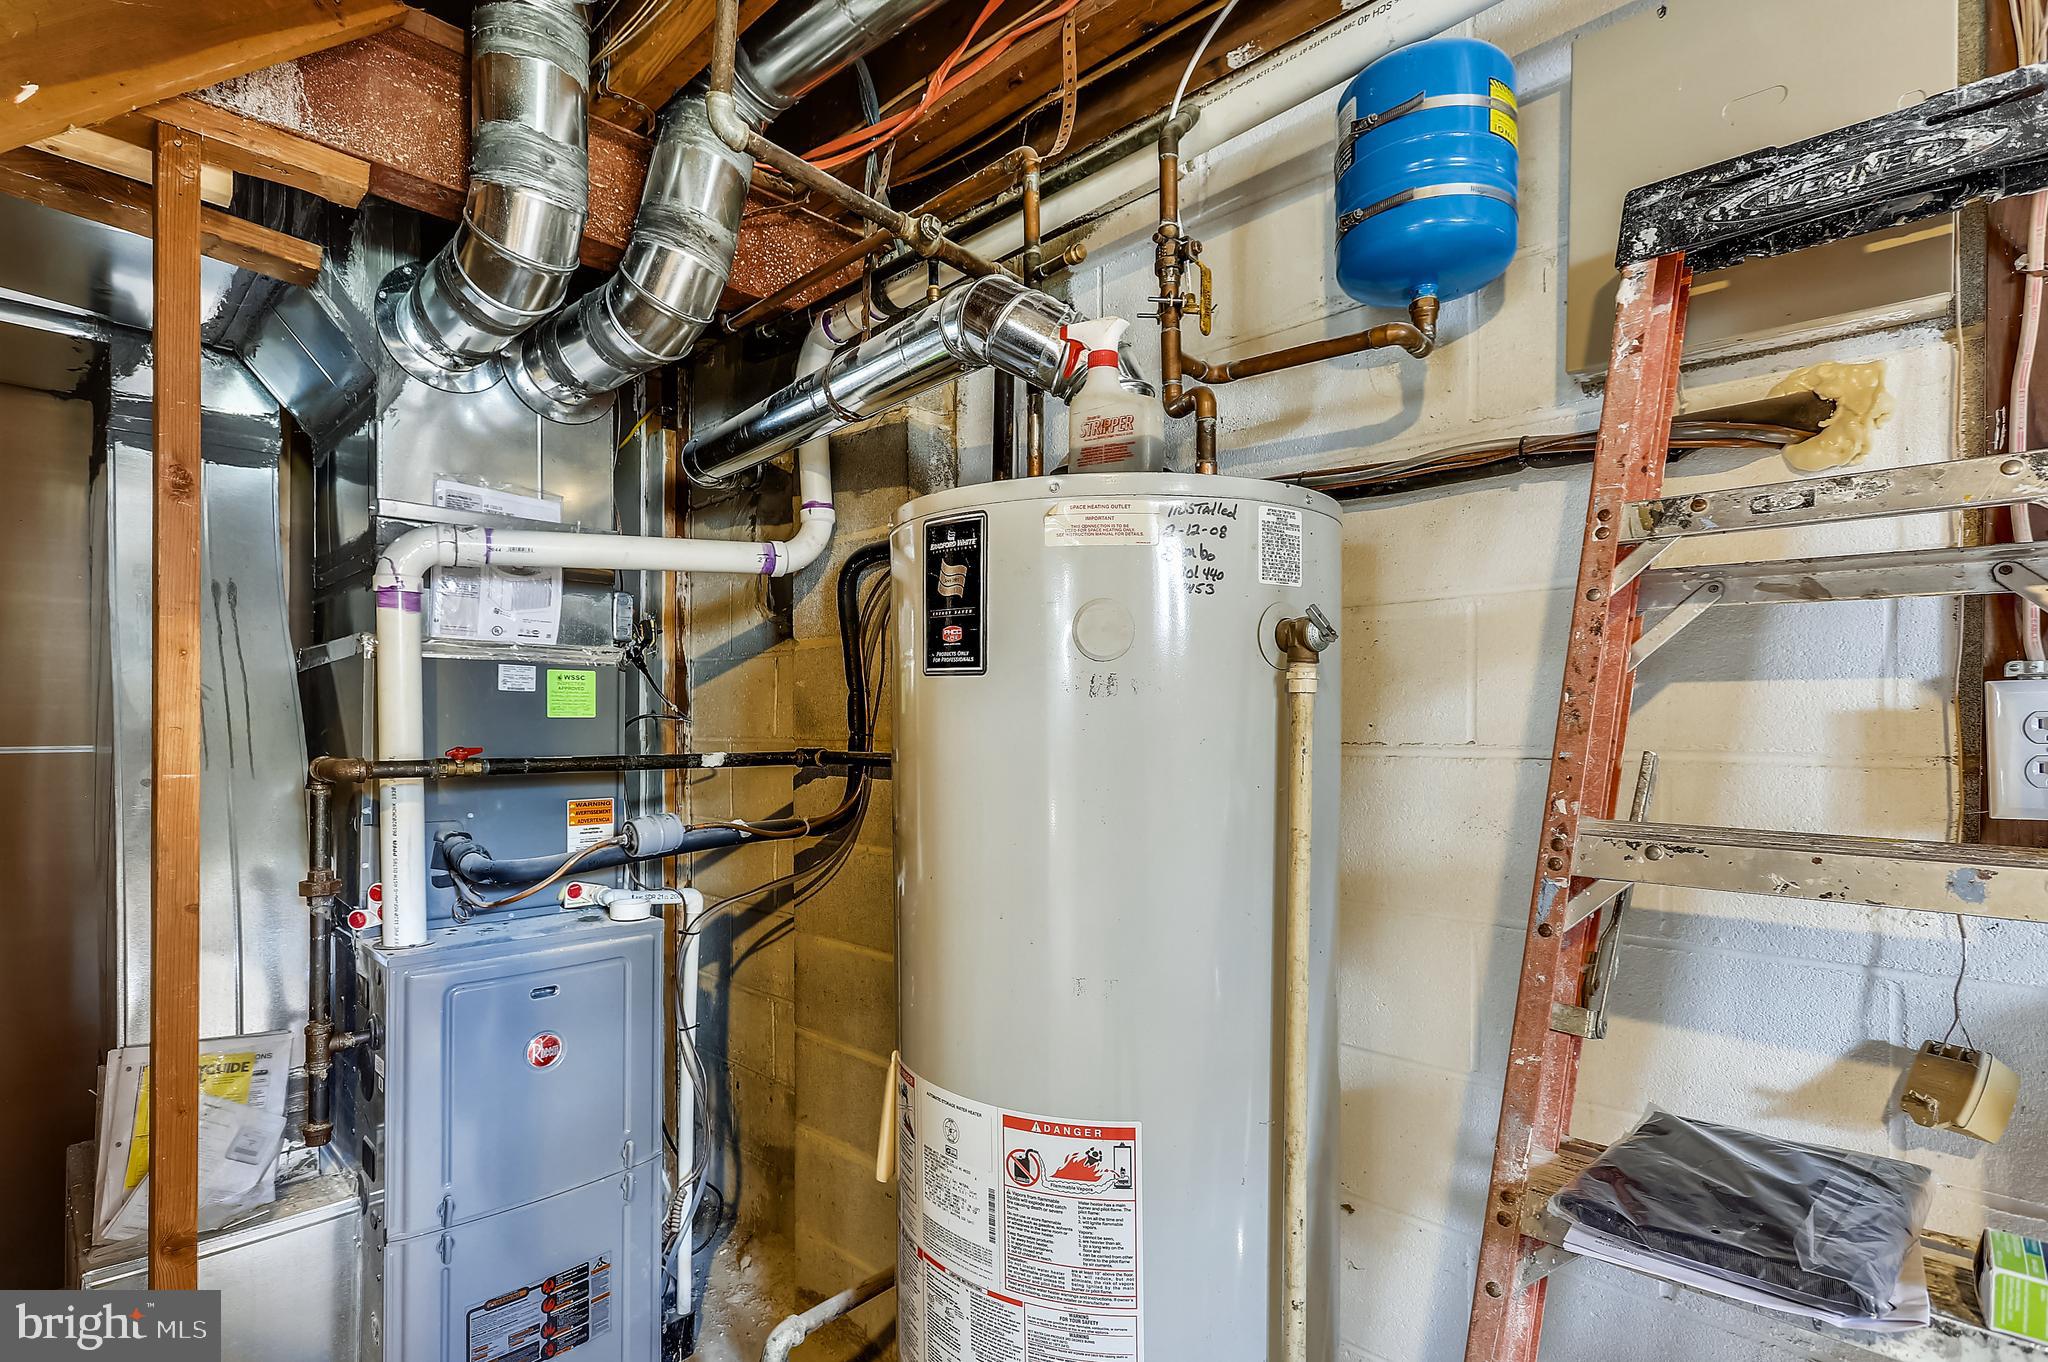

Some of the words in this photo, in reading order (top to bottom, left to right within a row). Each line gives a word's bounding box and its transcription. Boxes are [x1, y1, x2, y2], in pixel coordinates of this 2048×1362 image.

[1372, 0, 1393, 18] SCH
[1357, 14, 1371, 26] 40
[1308, 36, 1329, 51] WATER
[1271, 61, 1284, 71] PVC
[1214, 90, 1228, 103] ASTM
[1080, 415, 1135, 438] STRIPPER
[930, 541, 956, 550] BRADFORD
[957, 538, 978, 546] WHITE
[1203, 566, 1225, 581] 440
[1043, 1125, 1102, 1137] DANGER
